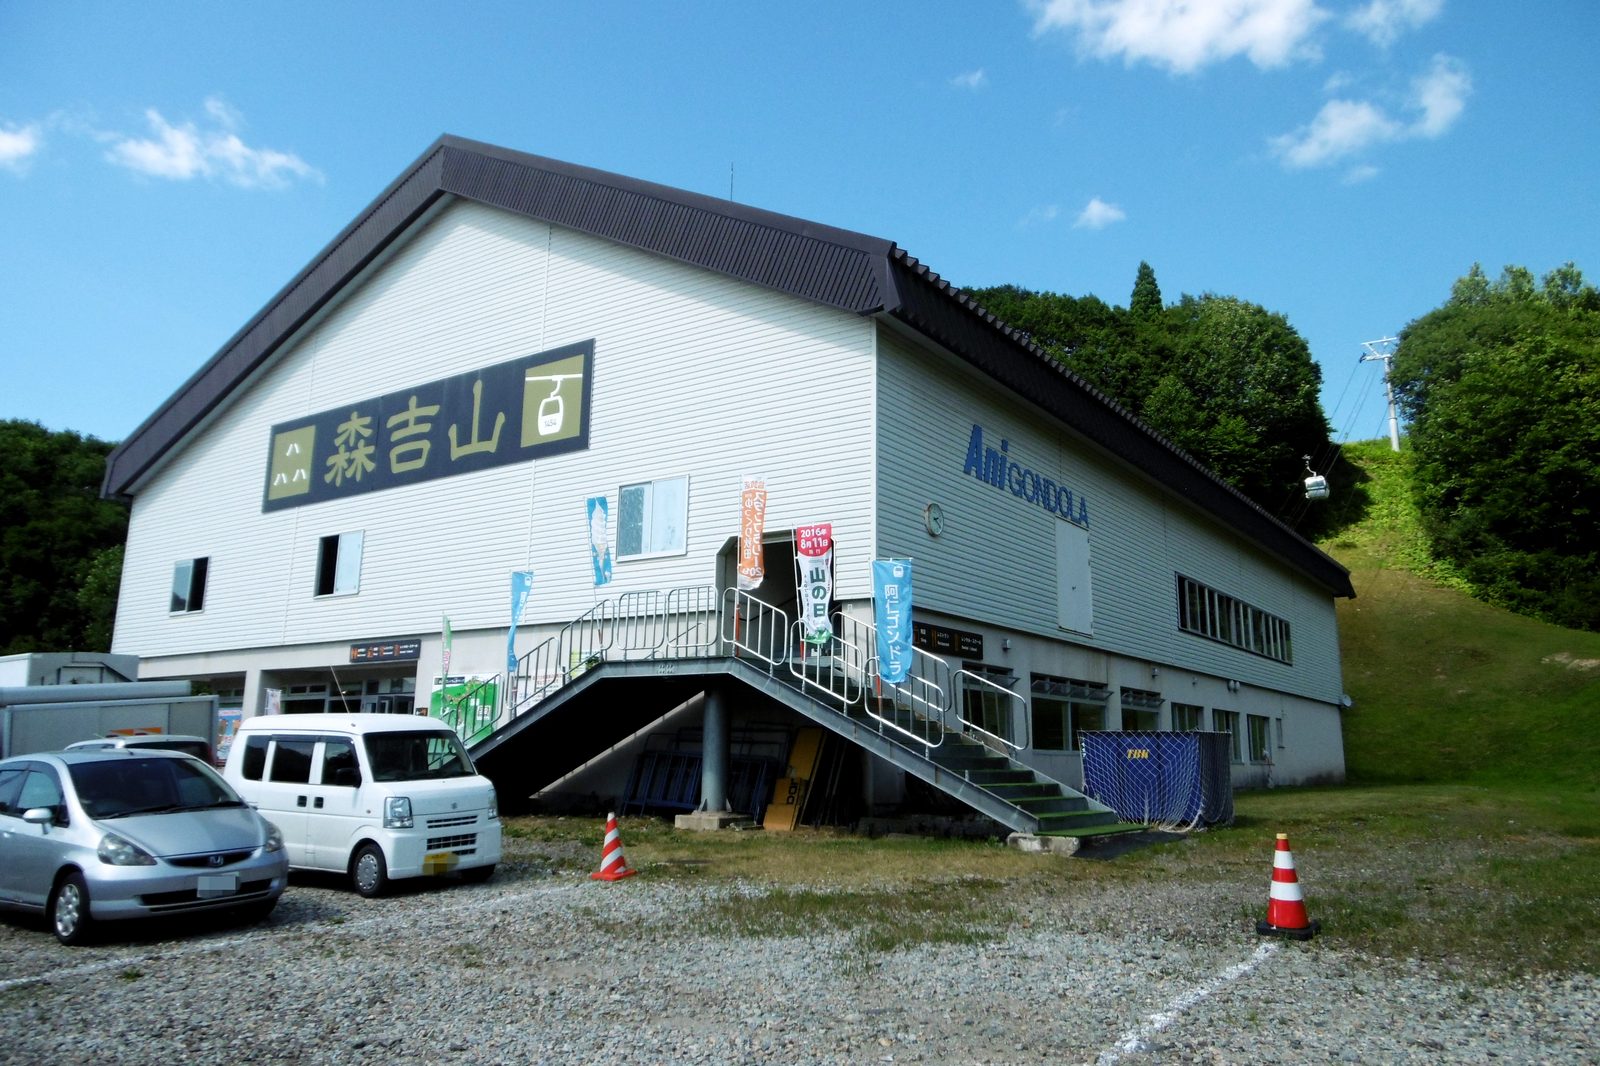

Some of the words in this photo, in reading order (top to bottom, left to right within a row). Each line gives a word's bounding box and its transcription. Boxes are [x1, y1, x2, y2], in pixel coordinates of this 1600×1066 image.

[324, 379, 506, 488] 森吉山
[963, 424, 1009, 490] Ani
[1008, 462, 1090, 528] GONDOLA
[800, 528, 827, 538] 2016年
[800, 537, 828, 550] 8月11日
[809, 567, 827, 618] 山の日
[884, 584, 902, 676] 阿仁ゴンドラ
